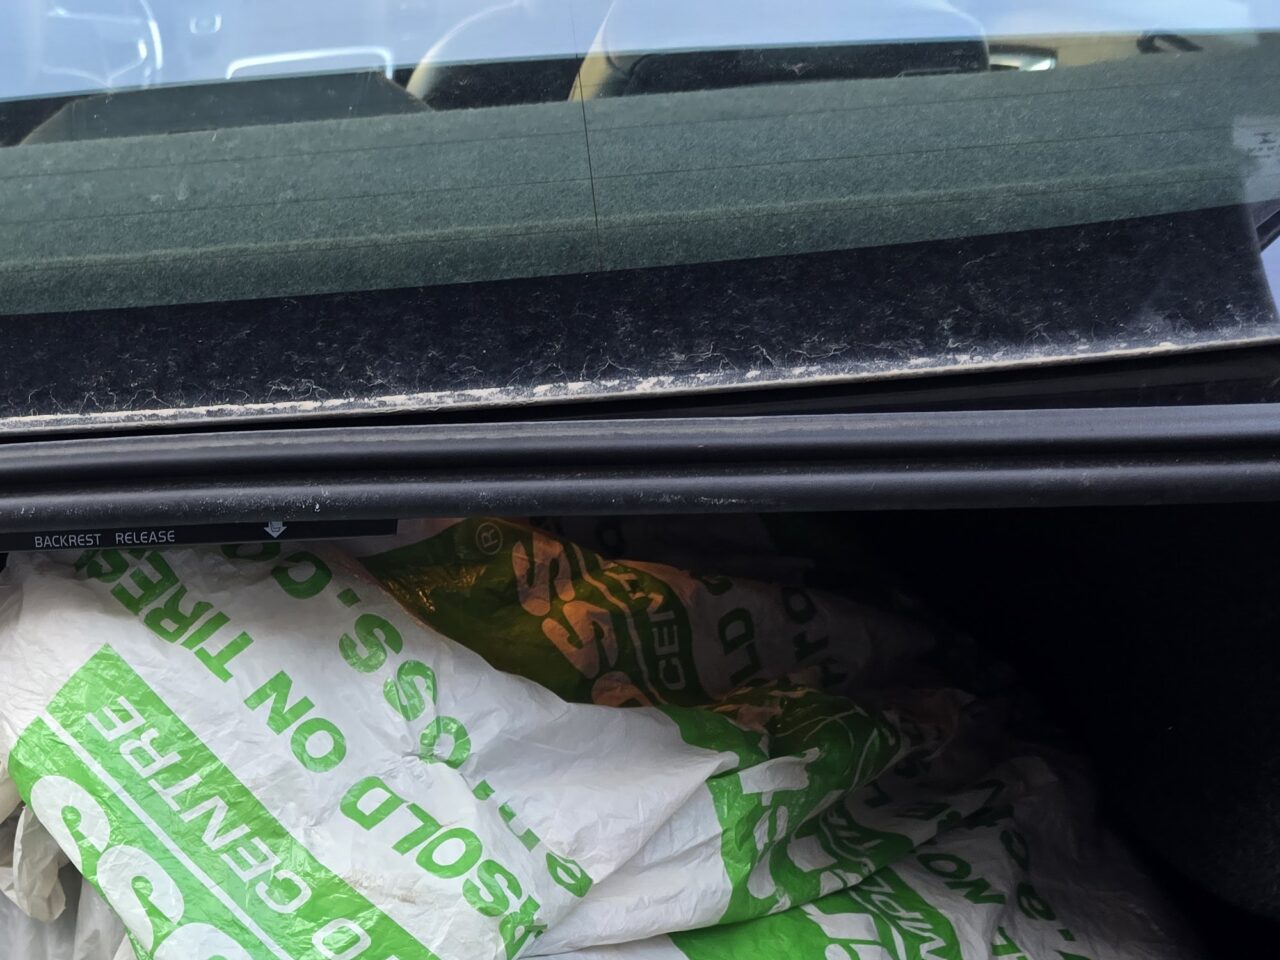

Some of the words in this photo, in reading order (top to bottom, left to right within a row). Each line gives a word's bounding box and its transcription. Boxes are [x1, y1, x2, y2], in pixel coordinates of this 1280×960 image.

[35, 533, 102, 548] BACKREST
[115, 530, 176, 545] RELEASE
[244, 671, 346, 773] ON
[85, 696, 313, 914] CENTRE
[917, 848, 1006, 904] NO
